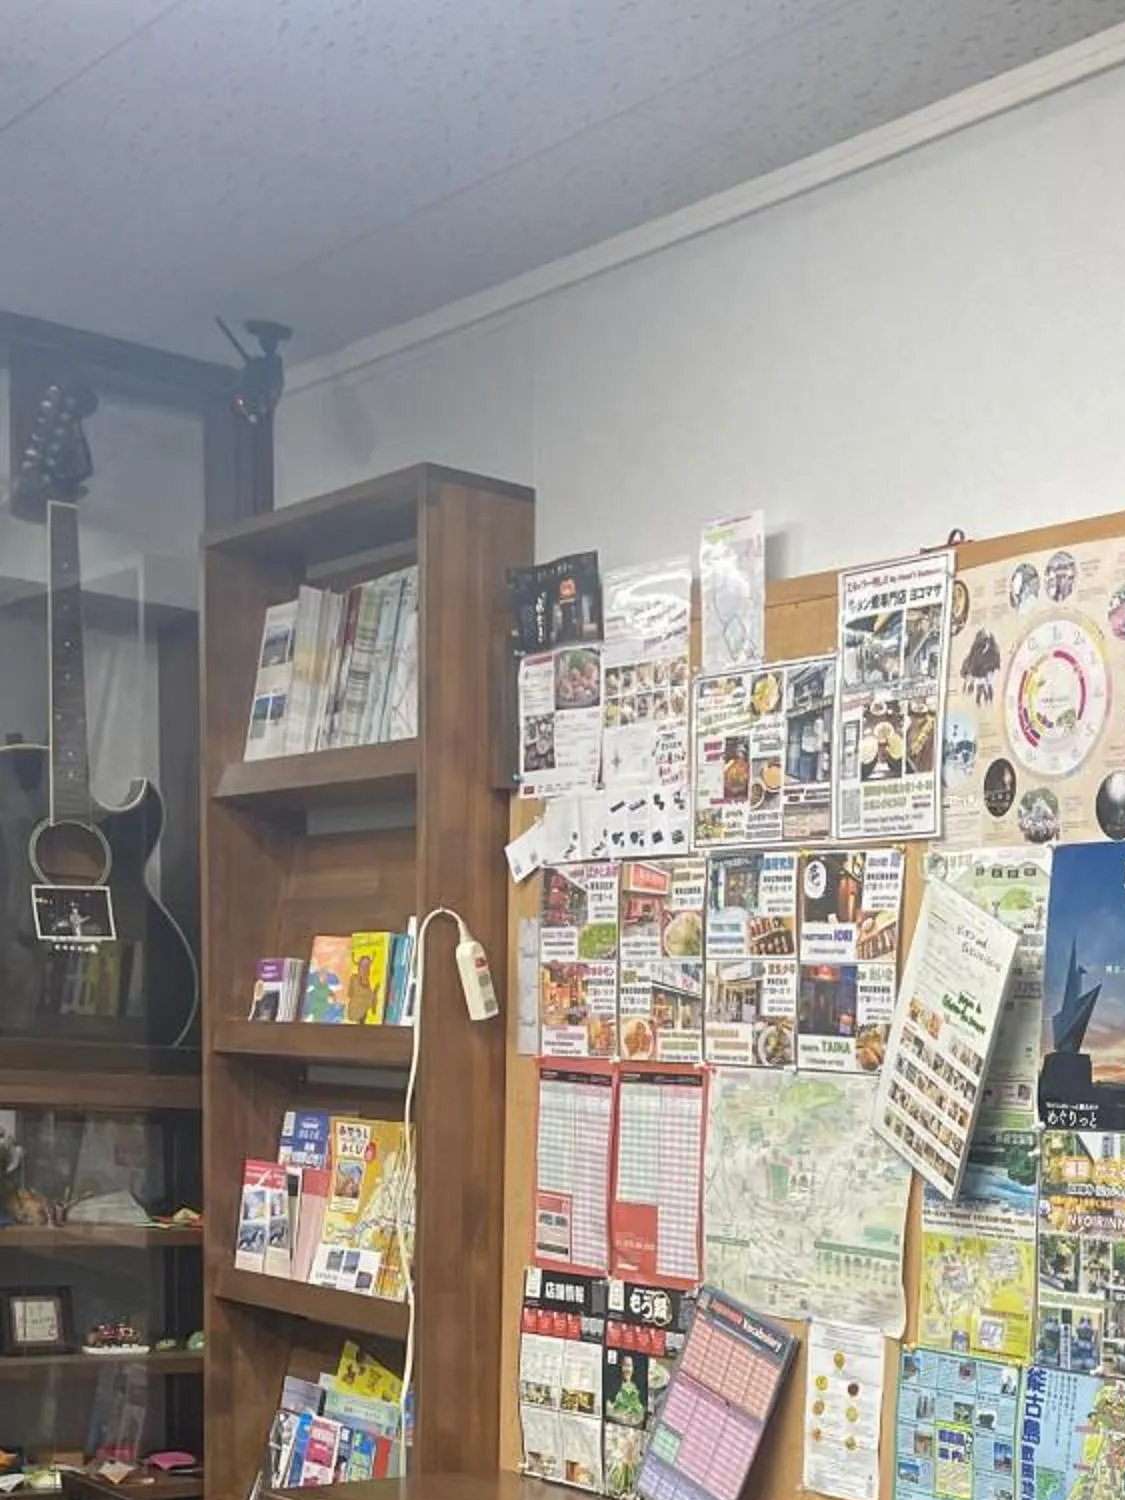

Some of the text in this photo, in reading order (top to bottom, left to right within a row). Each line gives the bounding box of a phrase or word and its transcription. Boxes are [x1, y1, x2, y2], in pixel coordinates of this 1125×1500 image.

[1047, 1111, 1098, 1129] めぐりっと
